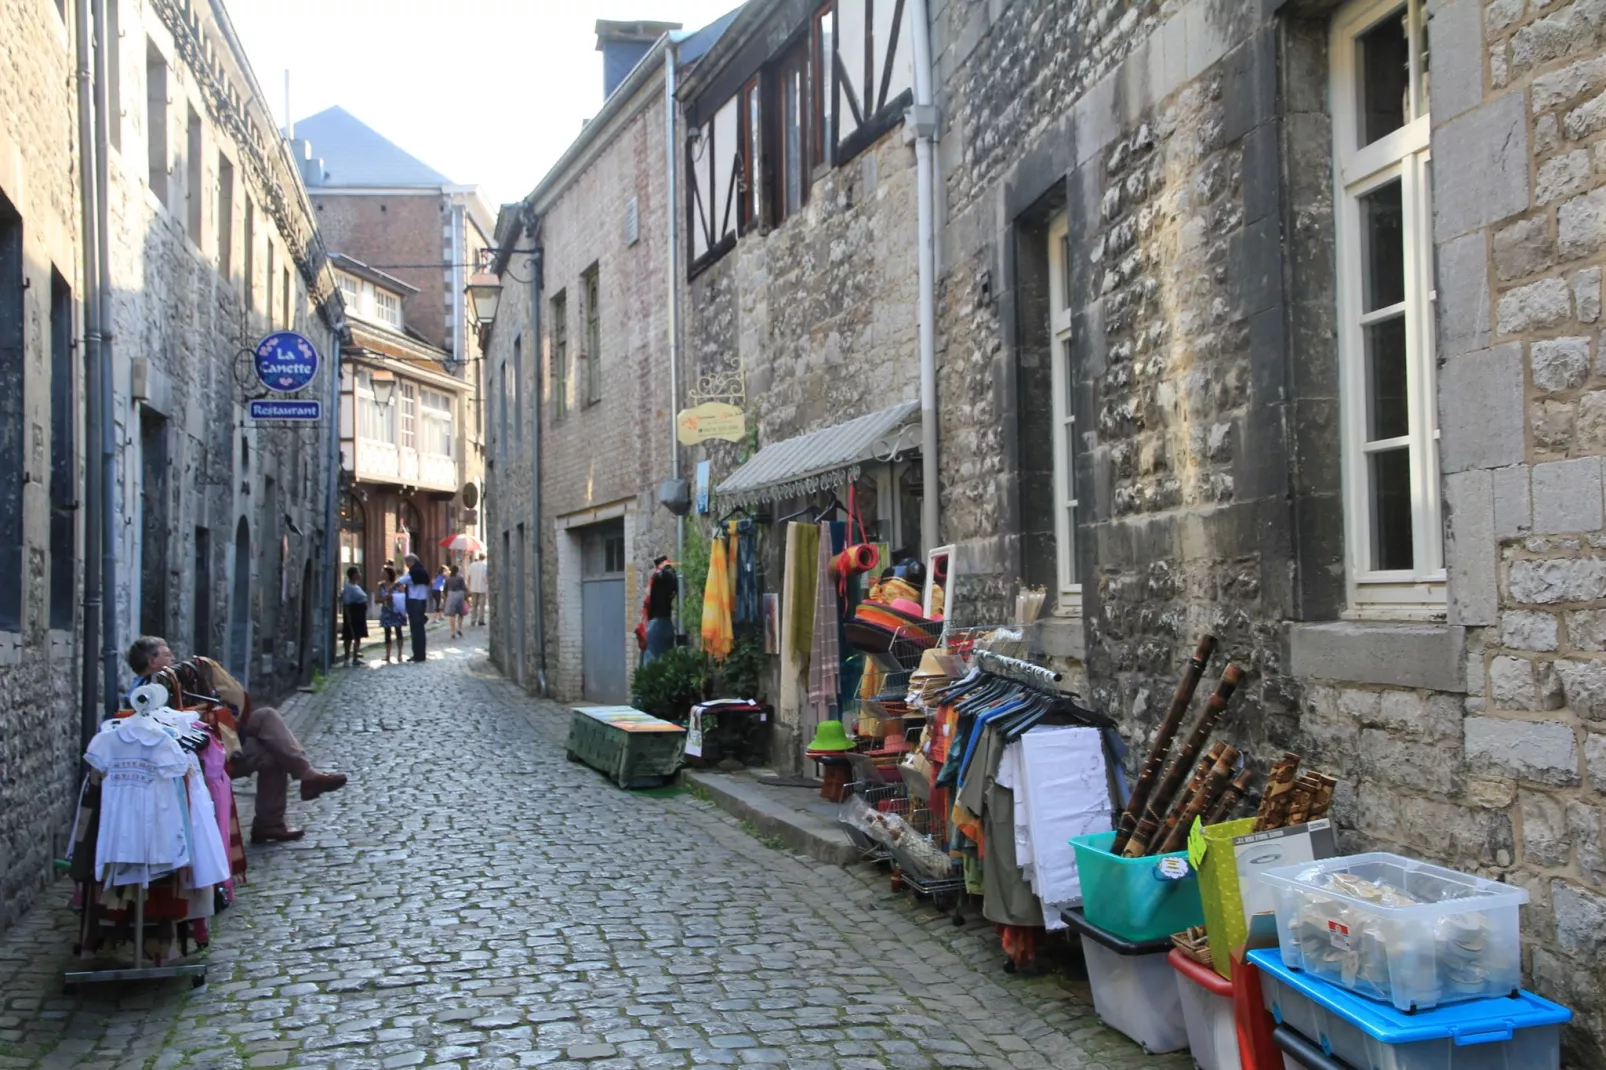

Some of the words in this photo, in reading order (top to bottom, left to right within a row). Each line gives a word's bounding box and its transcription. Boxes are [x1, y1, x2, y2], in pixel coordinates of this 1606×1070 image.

[276, 347, 295, 360] La
[261, 361, 311, 374] Canette
[253, 405, 316, 415] Restaurant
